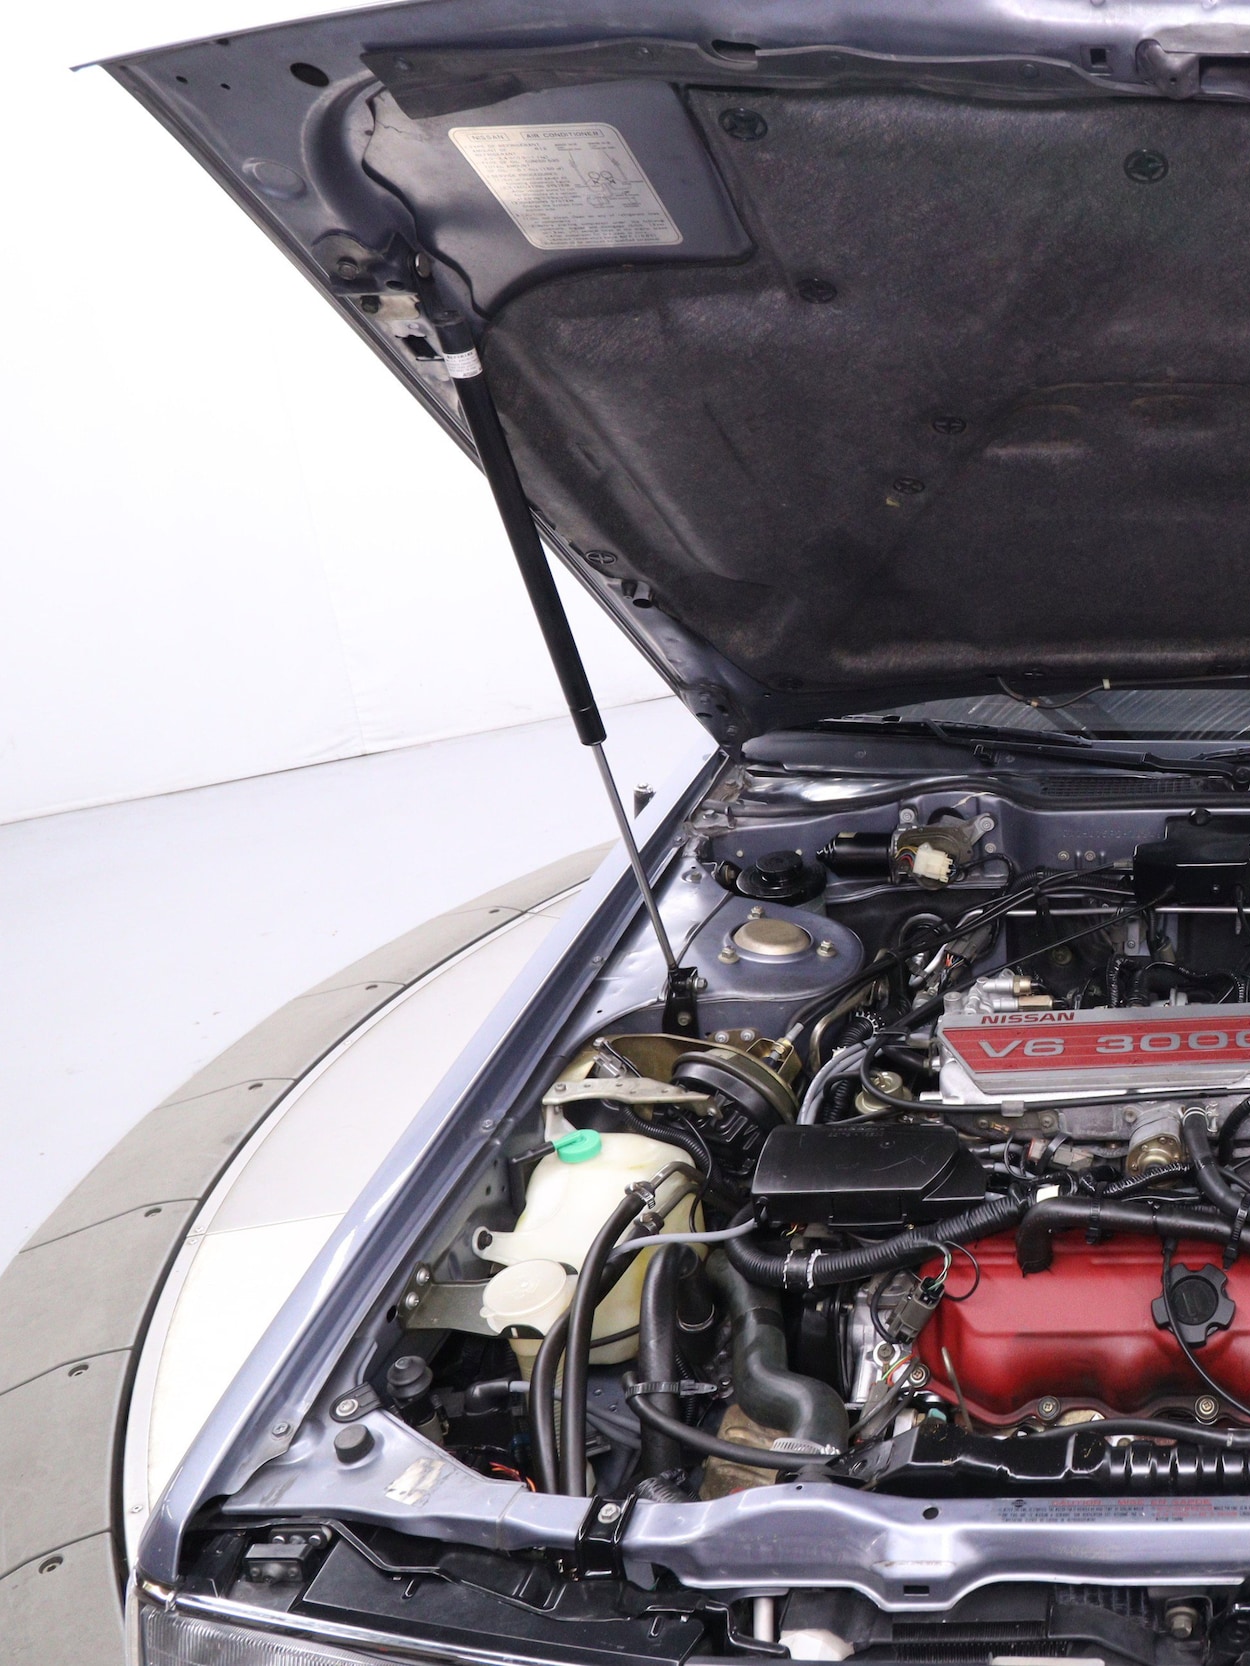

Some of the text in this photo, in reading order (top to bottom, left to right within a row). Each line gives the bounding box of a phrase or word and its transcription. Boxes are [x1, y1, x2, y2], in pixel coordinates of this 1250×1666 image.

[543, 130, 600, 138] CONDITIONER
[980, 1011, 1075, 1026] NISSAN
[978, 1037, 1066, 1059] V6
